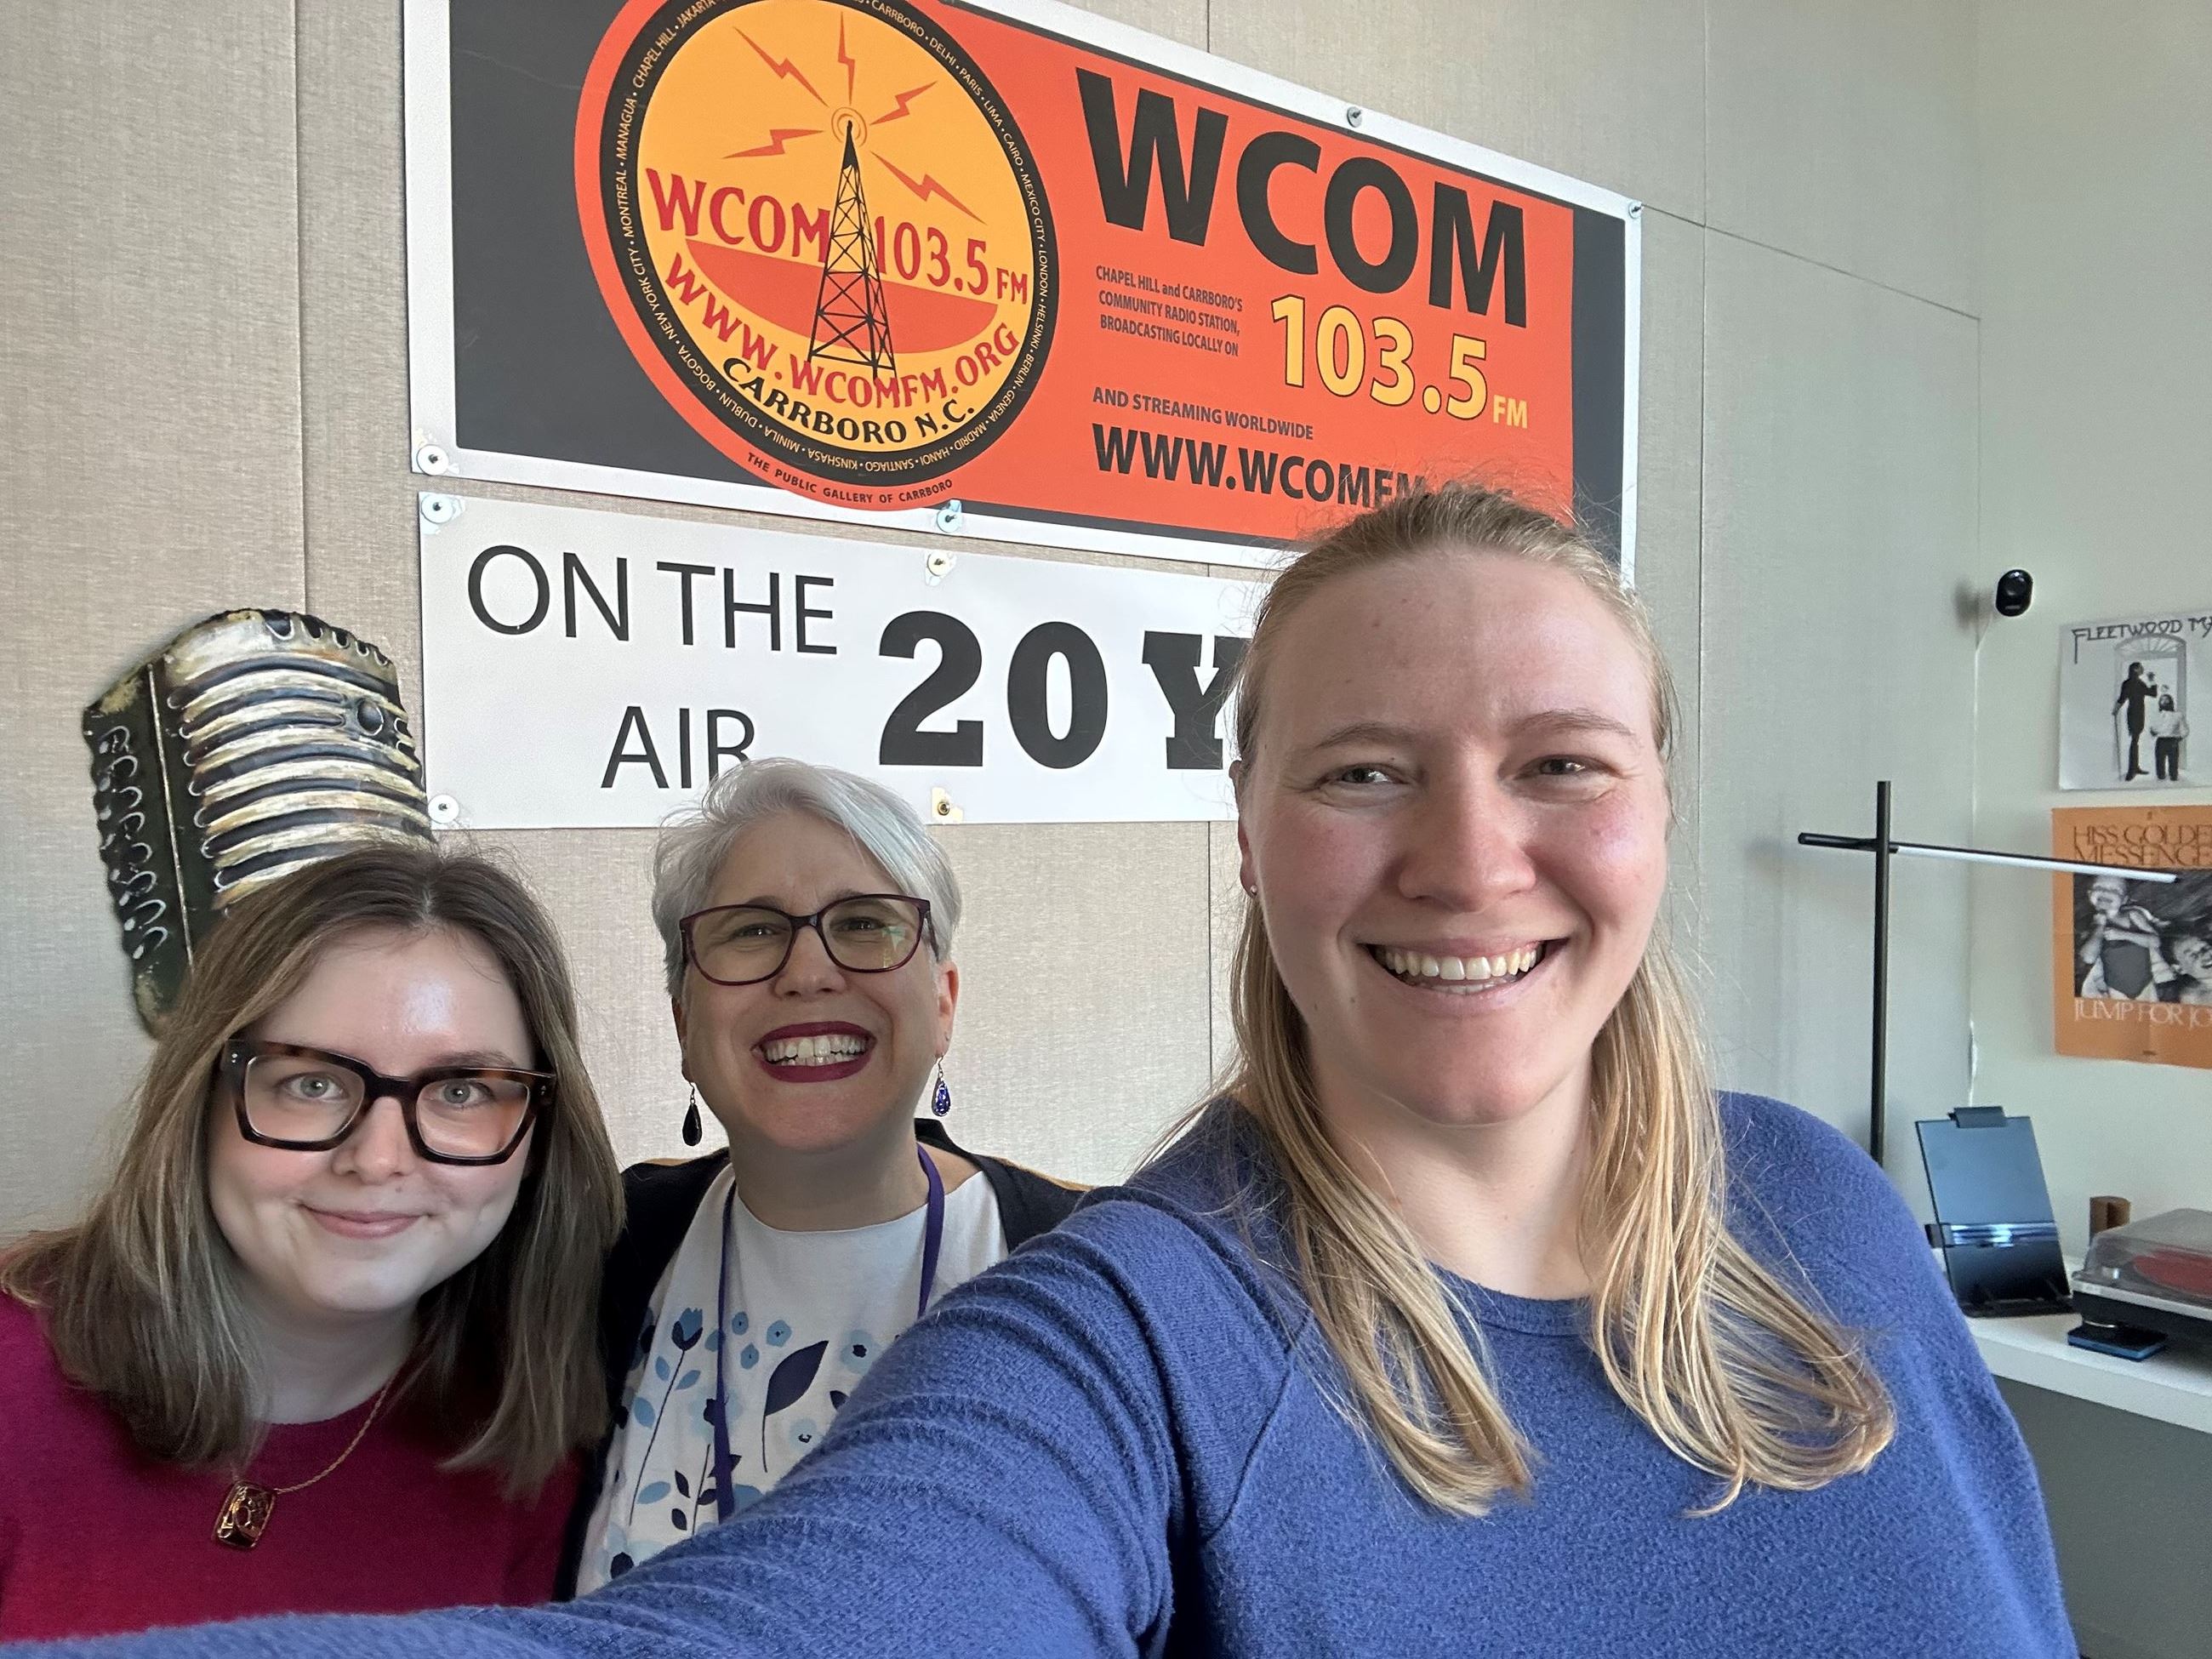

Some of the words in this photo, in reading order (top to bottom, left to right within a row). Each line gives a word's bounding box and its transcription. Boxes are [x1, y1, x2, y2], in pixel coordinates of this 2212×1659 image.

[655, 27, 677, 50] HILL
[871, 0, 925, 37] CARRBORO
[632, 48, 662, 88] CHAPEL
[929, 37, 957, 66] DELHI
[959, 67, 983, 96] PARIS
[616, 98, 637, 161] MANAGUA
[983, 100, 1002, 128] LIMA
[1003, 133, 1023, 167] CAIRO
[616, 169, 635, 238] MONTREAL
[1022, 174, 1040, 216] MEXICO
[1076, 66, 1527, 328] WCOM
[646, 168, 830, 263] WCOM
[875, 215, 989, 295] 103.5
[996, 267, 1028, 305] FM
[1034, 217, 1046, 242] CITY
[628, 248, 646, 276] CITY
[1038, 249, 1048, 298] LONDON
[638, 276, 660, 311] YORK
[1096, 265, 1136, 288] CHAPEL
[1137, 275, 1160, 294] HILL
[1162, 283, 1180, 298] and
[1183, 285, 1243, 312] CARRBORO'S
[654, 311, 678, 340] NEW
[665, 252, 1020, 408] WWW.WCOMFM.ORG
[1032, 304, 1046, 350] HELSINKI
[1098, 290, 1162, 317] COMMUNITY
[1165, 305, 1196, 324] RADIO
[1198, 312, 1240, 336] STATION,
[1100, 314, 1180, 344] BROADCASTING
[1182, 331, 1223, 353] LOCALLY
[1224, 341, 1239, 356] ON
[678, 345, 716, 391] BOGOTA
[1013, 354, 1035, 388] BERLIN
[1271, 294, 1488, 420] 103.5
[1493, 395, 1528, 429] FM
[719, 392, 758, 428] DUBLIN
[723, 357, 907, 444] CARRBORO
[915, 398, 974, 438] N.C.
[988, 390, 1015, 423] GENEVA
[1092, 386, 1129, 408] AND
[1132, 393, 1222, 424] STREAMING
[1225, 410, 1314, 440] WORLDWIDE
[765, 425, 801, 453] MINILA
[920, 447, 950, 466] HANOI
[954, 422, 988, 451] MADRID
[748, 452, 770, 472] THE
[774, 468, 818, 493] PUBLIC
[823, 487, 873, 504] GALLERY
[879, 494, 892, 504] OF
[898, 478, 953, 503] CARRBORO
[807, 448, 858, 470] KINSHASA
[865, 458, 915, 472] SANTIAGO
[468, 544, 630, 641] ON
[657, 561, 837, 654] THE
[2071, 619, 2182, 664] FLEETWOOD
[879, 610, 1108, 769] 20
[601, 705, 755, 789] AIR
[2074, 999, 2135, 1022] JUMP
[2139, 1002, 2184, 1025] FOR
